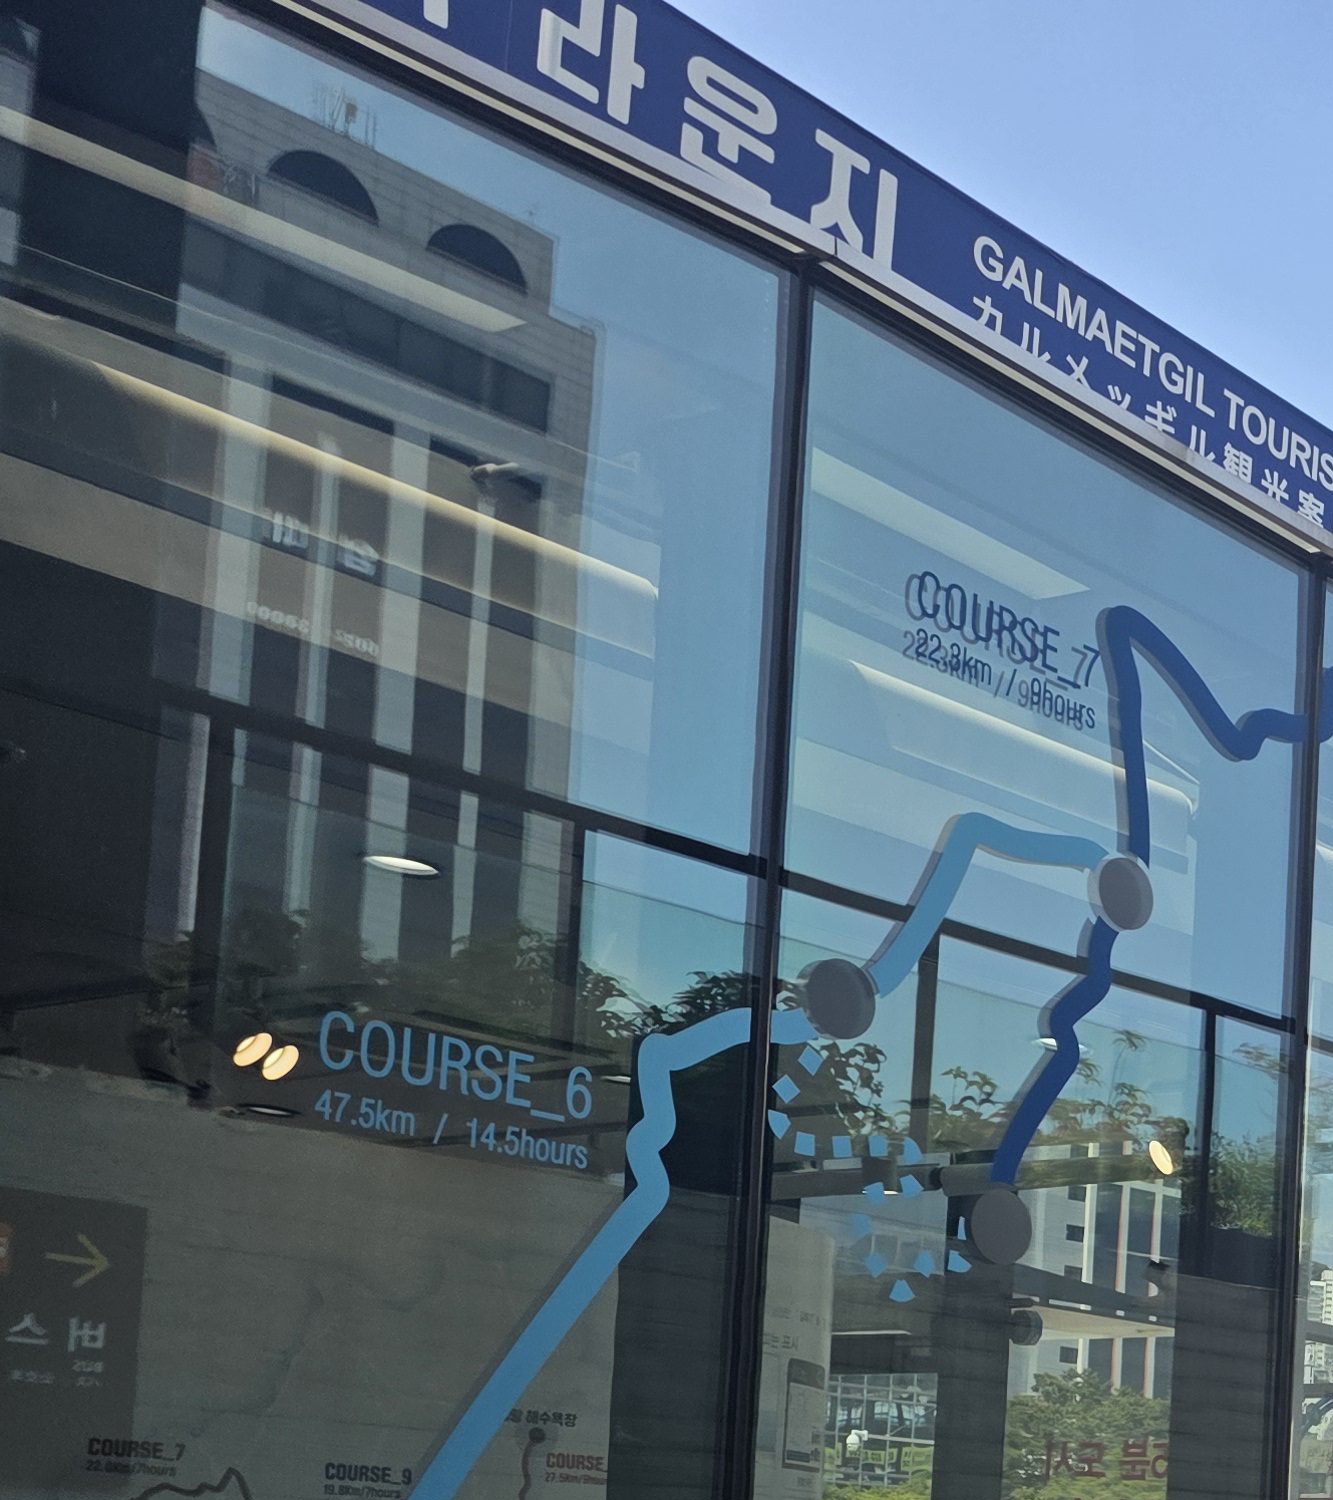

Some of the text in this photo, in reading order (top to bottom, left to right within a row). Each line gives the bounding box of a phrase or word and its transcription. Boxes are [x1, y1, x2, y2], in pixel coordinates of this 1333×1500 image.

[973, 235, 1215, 418] GALMAETGIL
[917, 571, 1100, 690] COURSE_7
[319, 1010, 592, 1122] COURSE_6
[314, 1089, 588, 1170] 47.5km / 14.5hours
[87, 1437, 186, 1462] COURSE_7
[325, 1462, 413, 1486] COURSE_9
